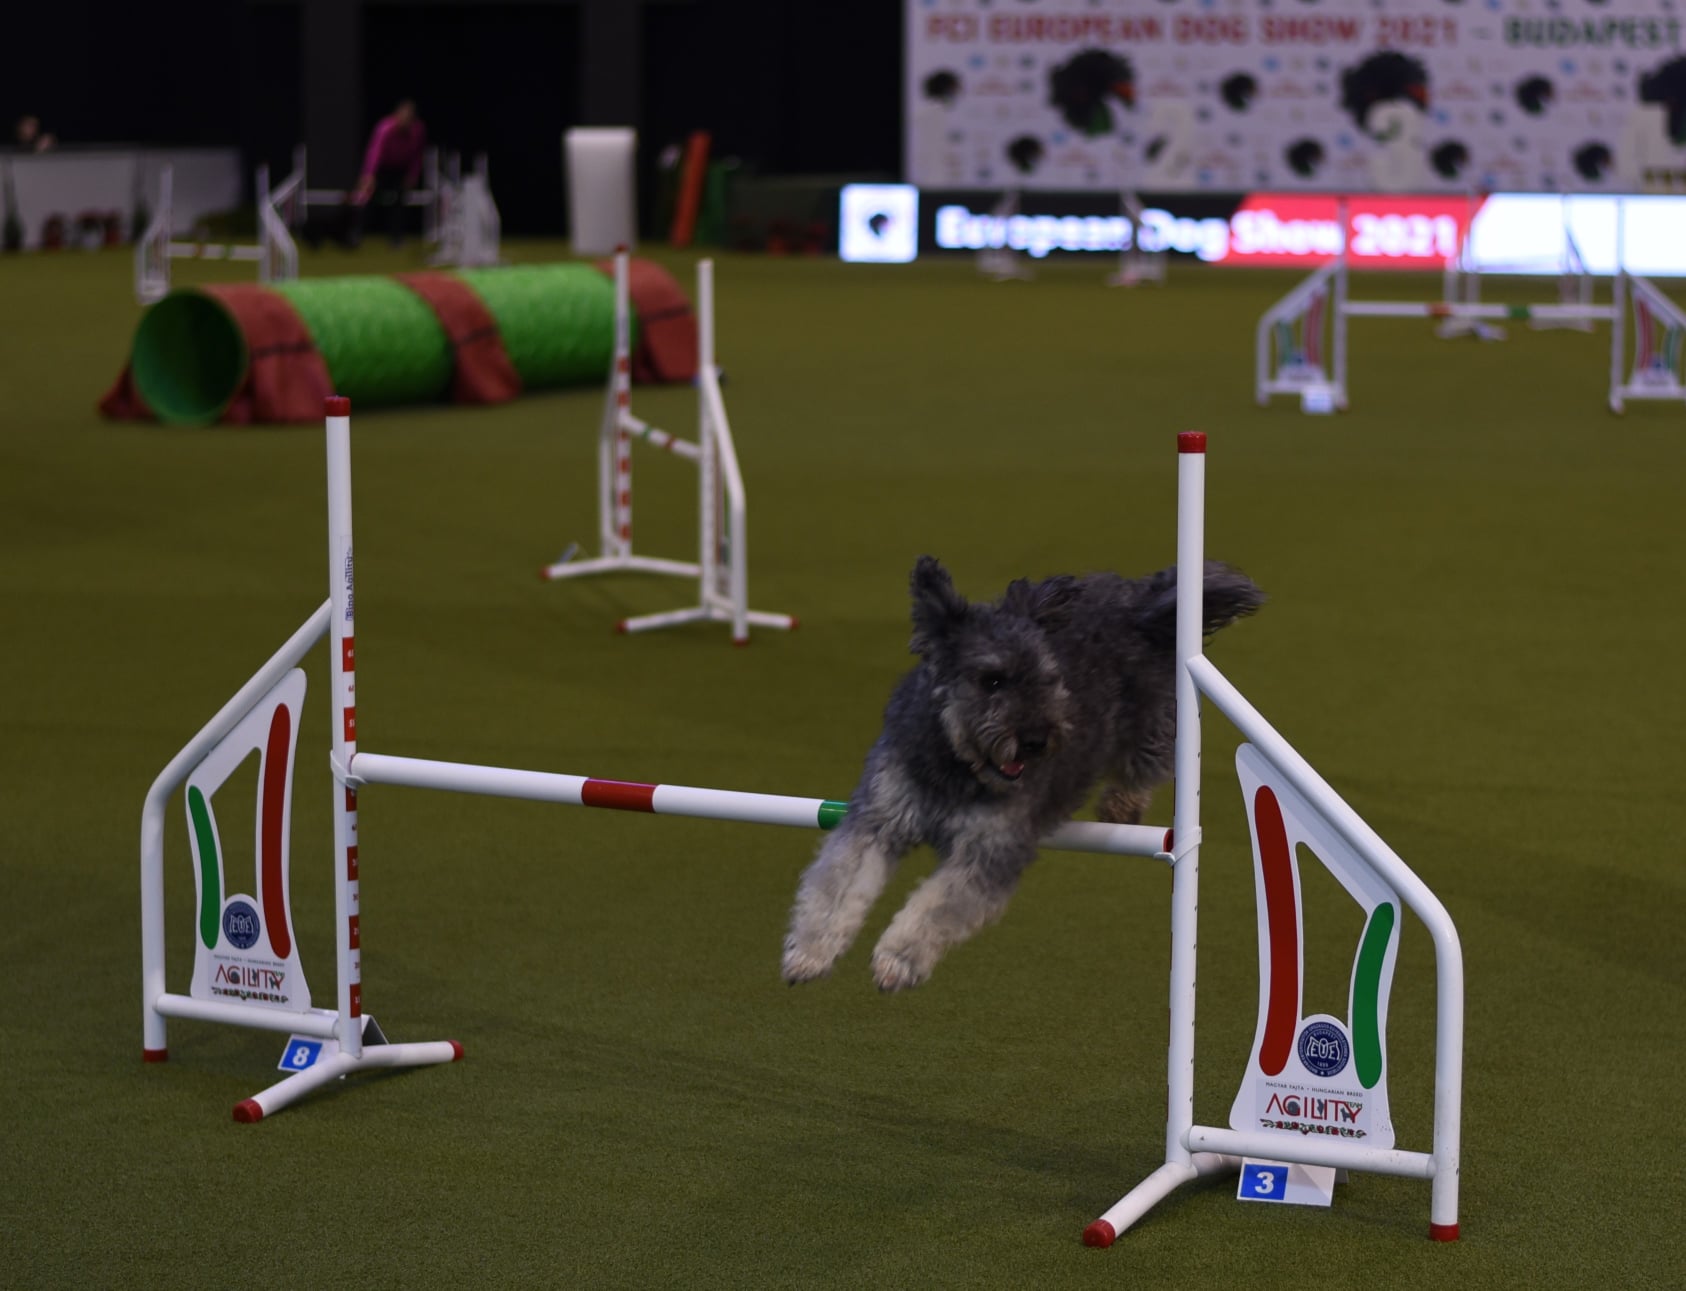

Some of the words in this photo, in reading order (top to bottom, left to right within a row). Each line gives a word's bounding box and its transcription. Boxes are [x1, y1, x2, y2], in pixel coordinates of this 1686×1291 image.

[989, 15, 1162, 44] EUROPEAN
[1174, 15, 1248, 45] DOG
[1261, 16, 1359, 45] SHOW
[1377, 16, 1456, 46] 2021
[1504, 16, 1680, 47] BUDAPEST
[935, 205, 1133, 258] European
[1137, 208, 1229, 261] Dog
[1231, 209, 1345, 254] Show
[1351, 213, 1457, 257] 2021
[215, 963, 285, 991] AGILITY
[292, 1046, 310, 1066] 8
[1311, 1087, 1344, 1096] HUNGARIAN
[1265, 1092, 1363, 1124] AGILITY
[1254, 1171, 1274, 1194] 3
